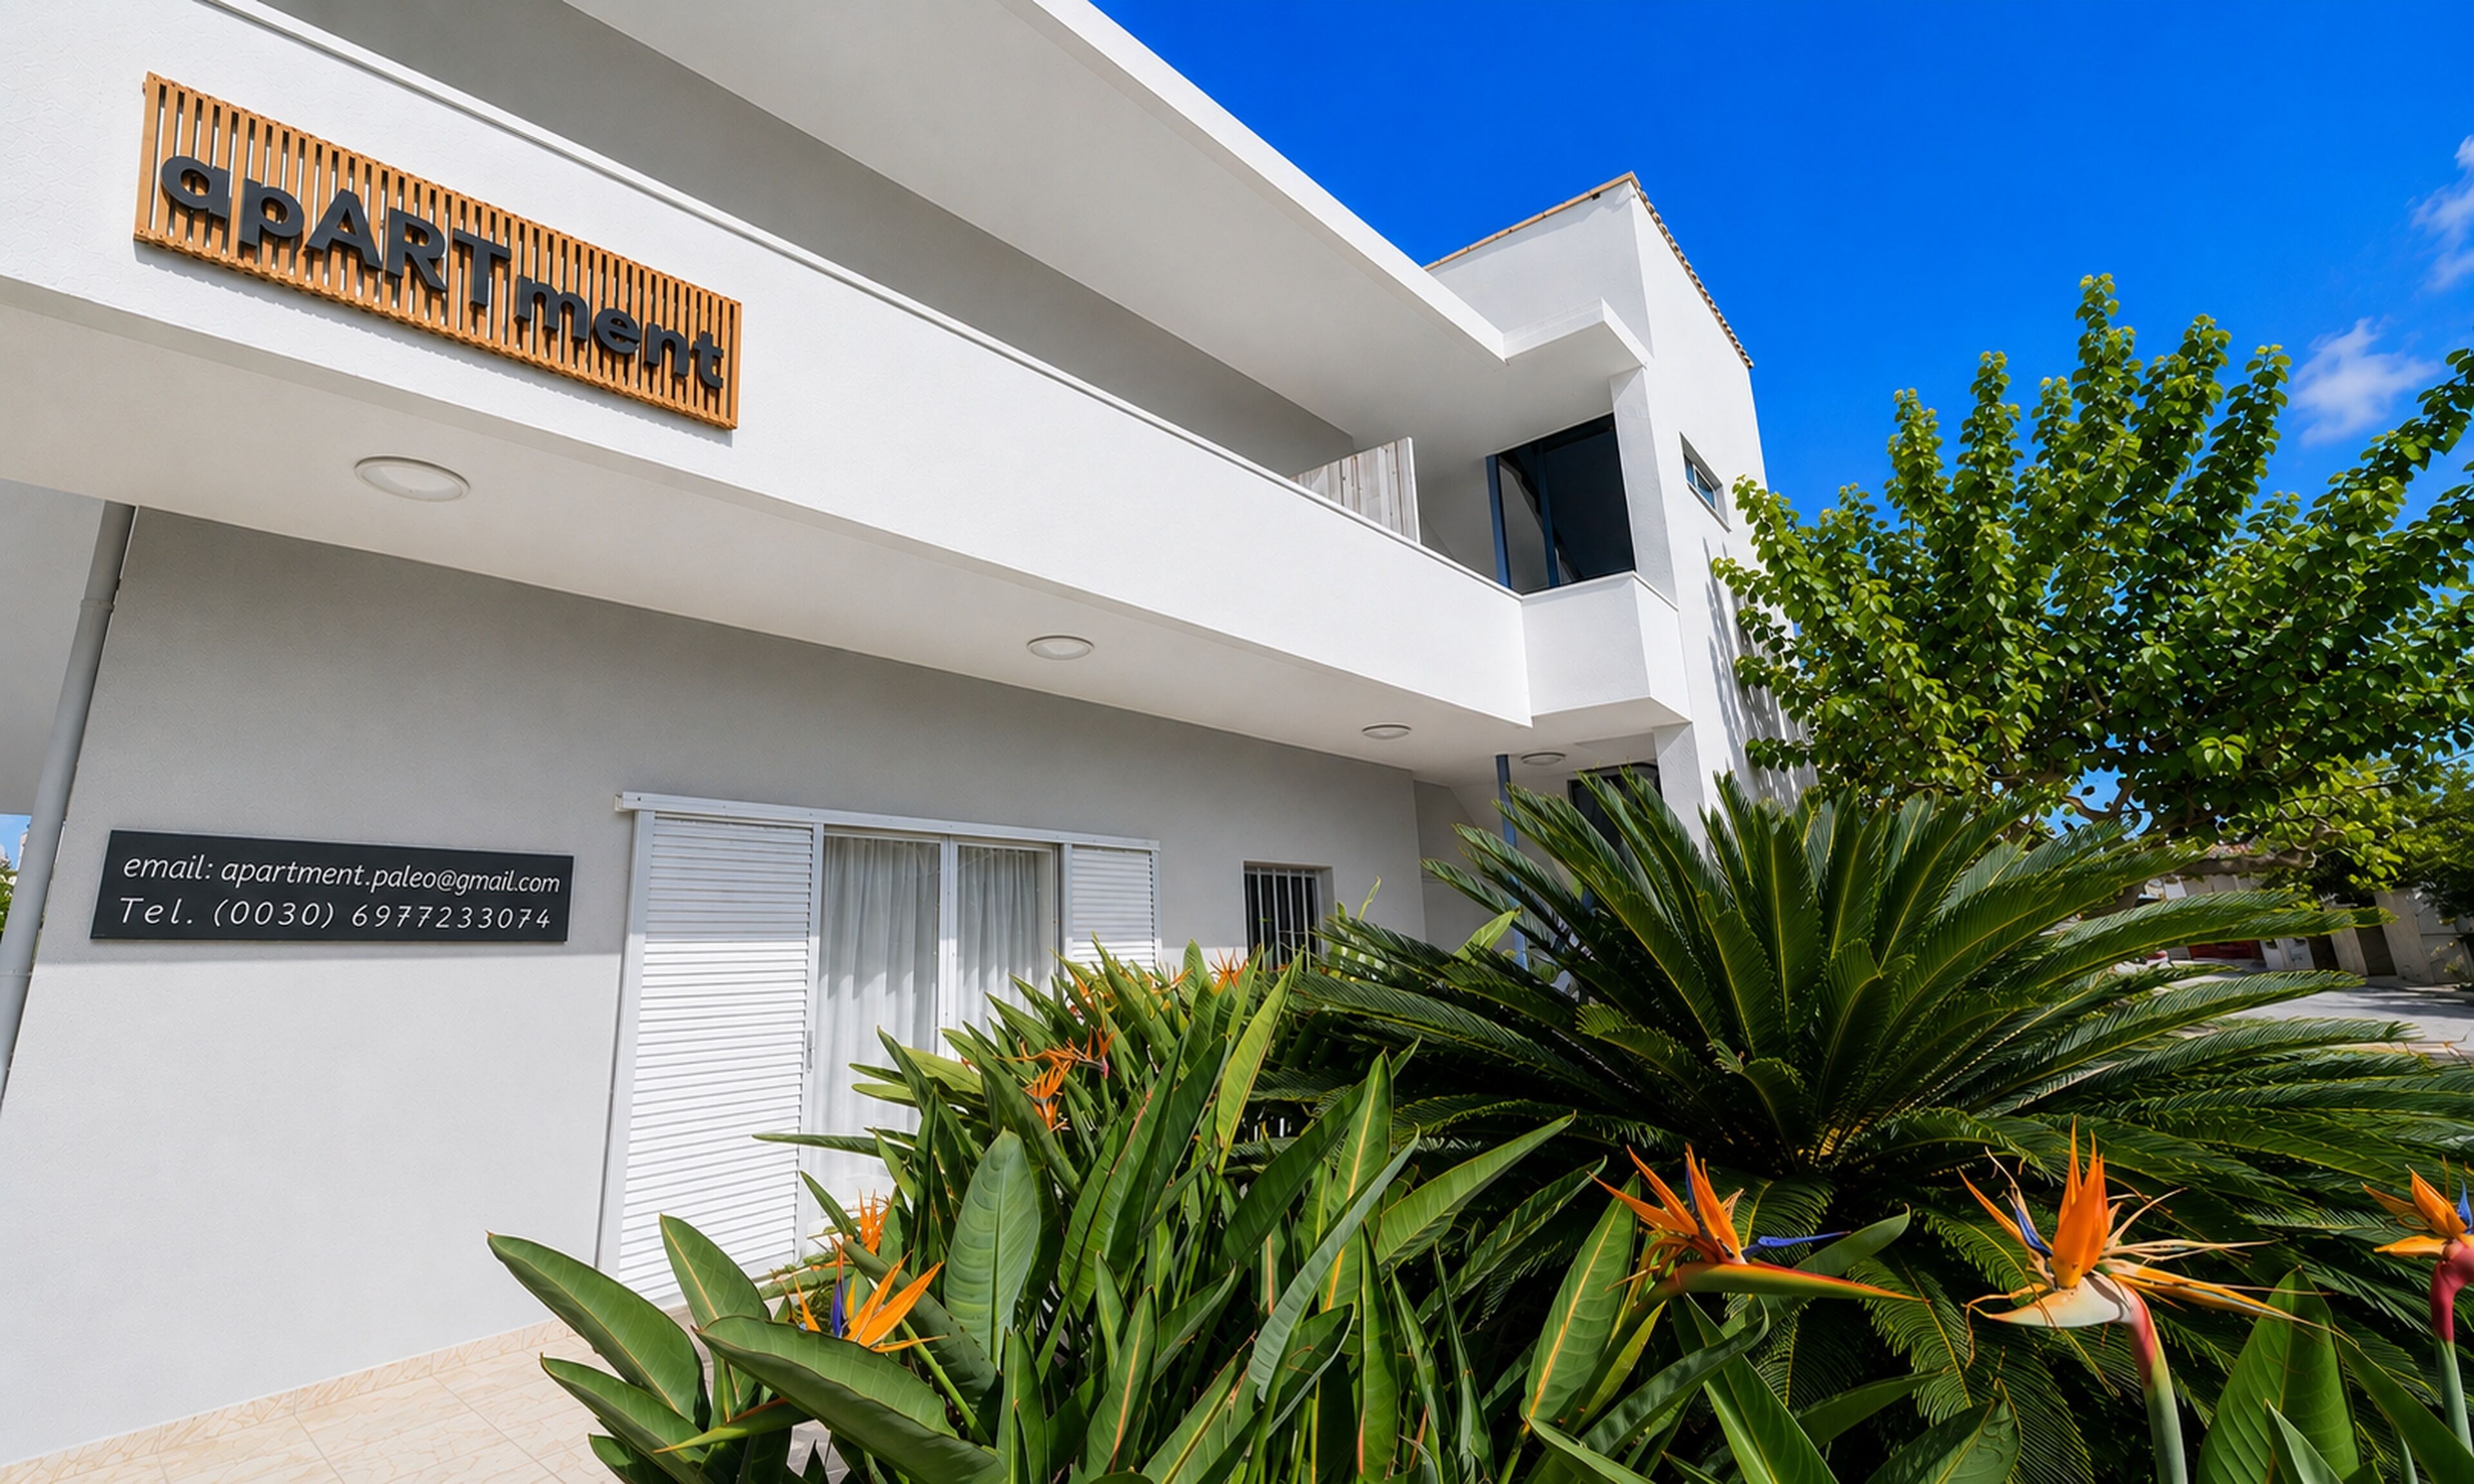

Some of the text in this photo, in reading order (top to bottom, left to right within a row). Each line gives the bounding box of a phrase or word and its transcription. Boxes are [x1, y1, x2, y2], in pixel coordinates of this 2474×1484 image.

[160, 155, 724, 390] apARTment
[124, 854, 560, 896] email: apartment.paleo@gmail.com
[120, 897, 550, 929] Tel. (0030) 6977233074
